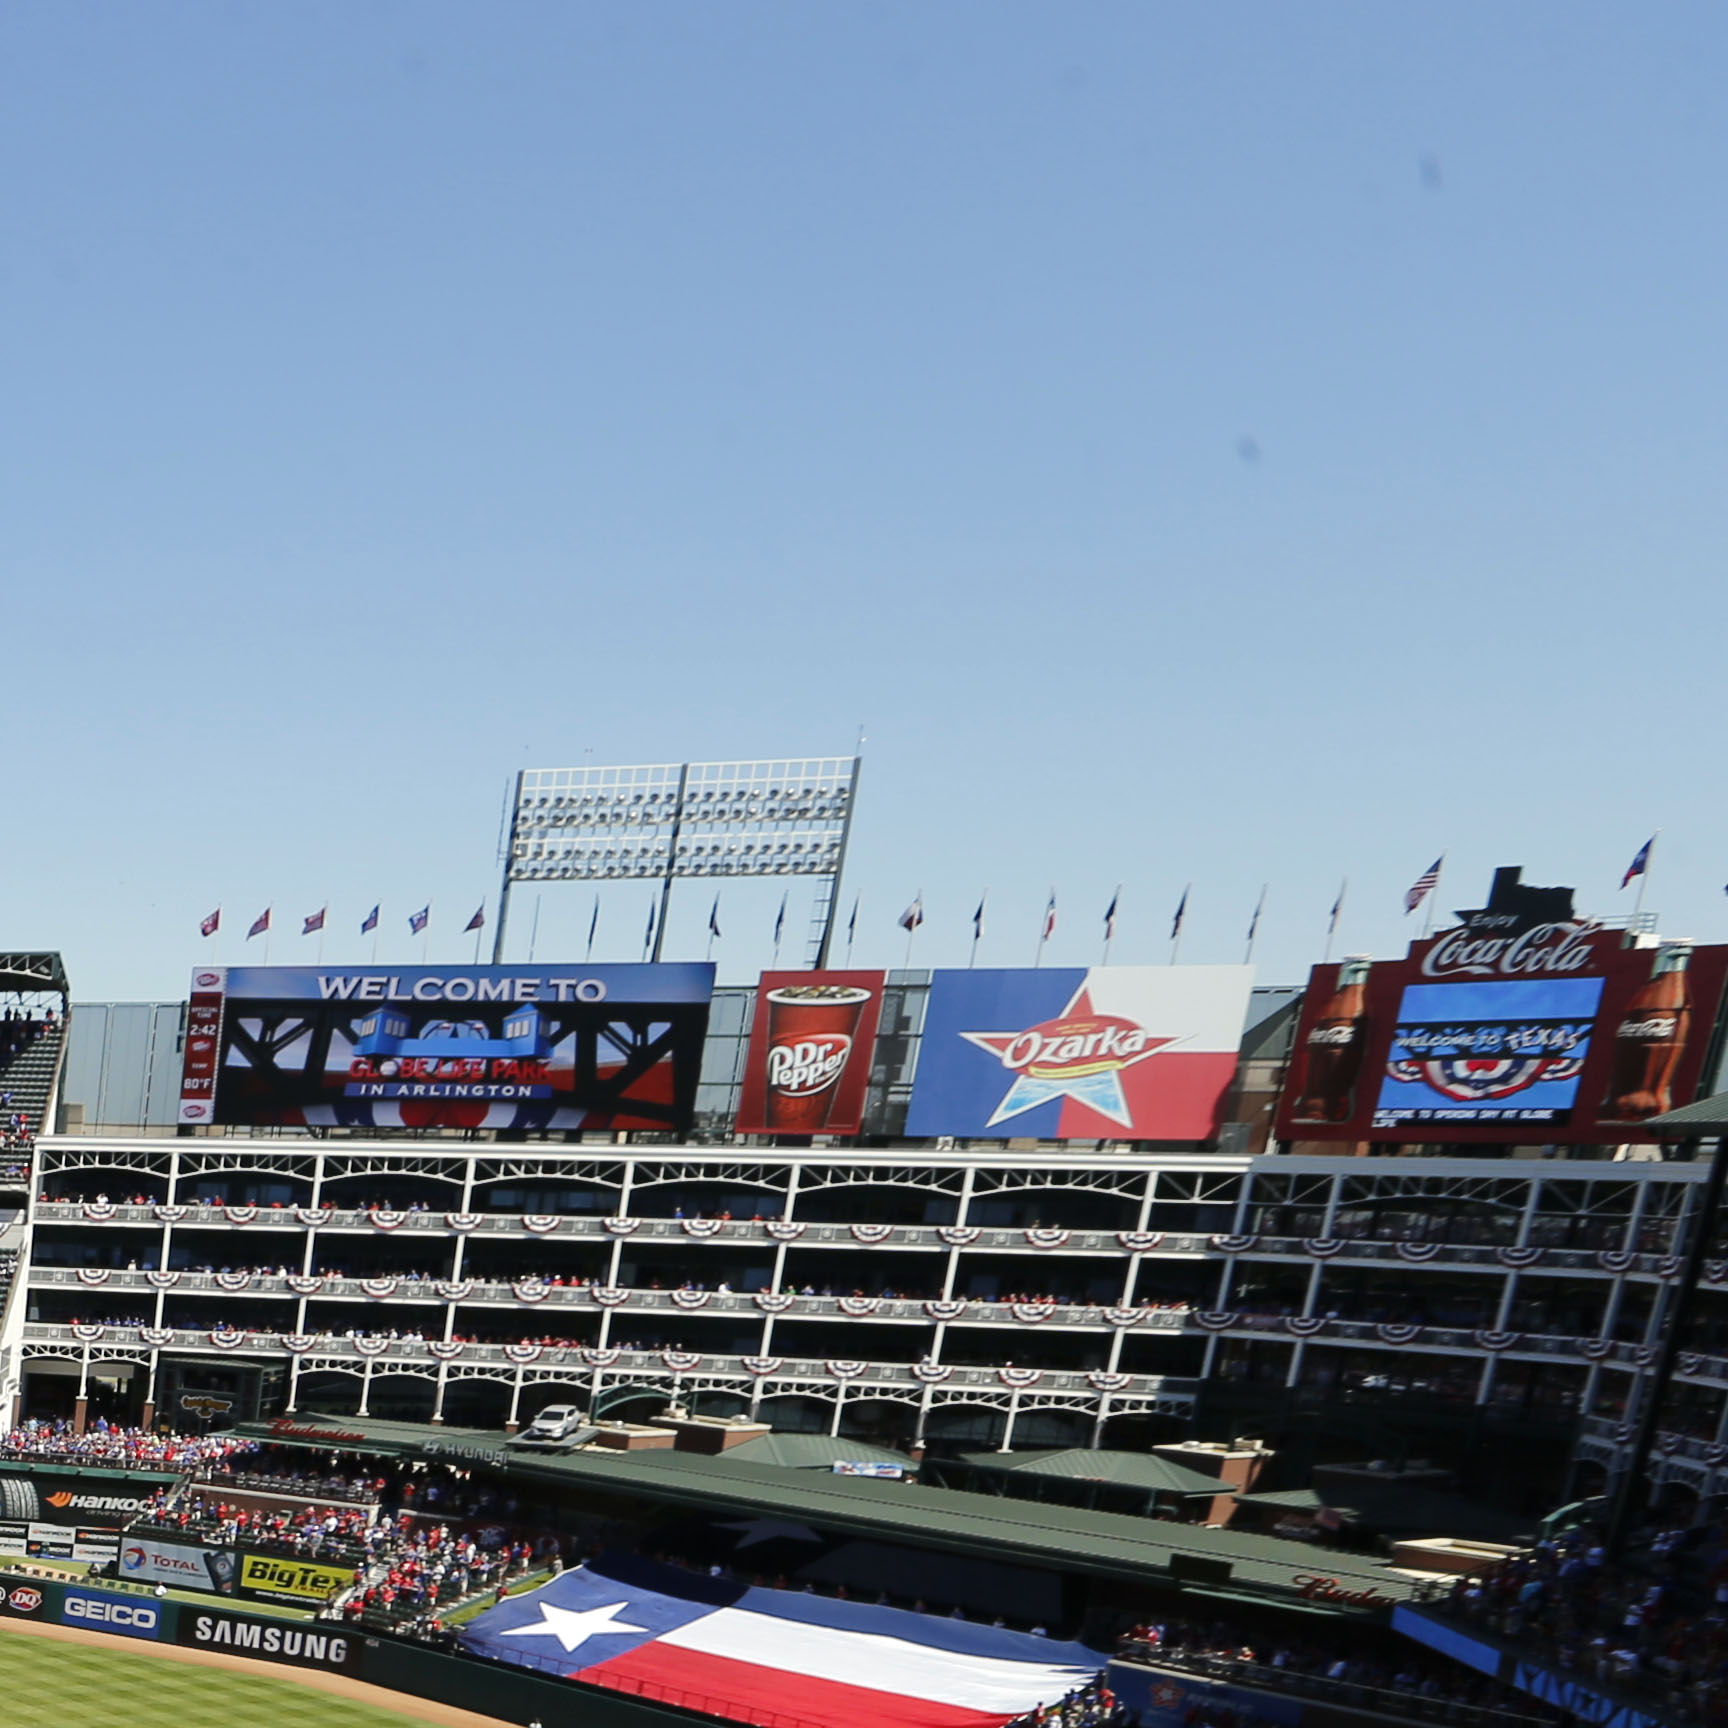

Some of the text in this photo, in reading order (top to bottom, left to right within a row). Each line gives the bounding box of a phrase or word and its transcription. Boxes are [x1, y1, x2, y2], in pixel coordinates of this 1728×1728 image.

[1470, 914, 1517, 930] Enjoy
[1421, 922, 1602, 977] Coca-Cola
[317, 976, 607, 1002] WELCOME TO
[190, 1025, 216, 1035] 2:42
[1396, 1030, 1580, 1051] WELCOME TO TEXAS
[794, 1042, 834, 1067] Dr
[1001, 1026, 1147, 1069] Ozarka
[432, 1058, 484, 1079] LIFE
[491, 1058, 552, 1080] PARK
[769, 1045, 848, 1090] Pepper
[360, 1084, 532, 1098] IN ARLINGTON
[445, 1443, 510, 1465] HYUNDAI
[152, 1554, 200, 1572] TOTAL
[14, 1591, 37, 1606] DQ
[64, 1597, 157, 1628] GEICO
[196, 1616, 347, 1663] SAMSUNG
